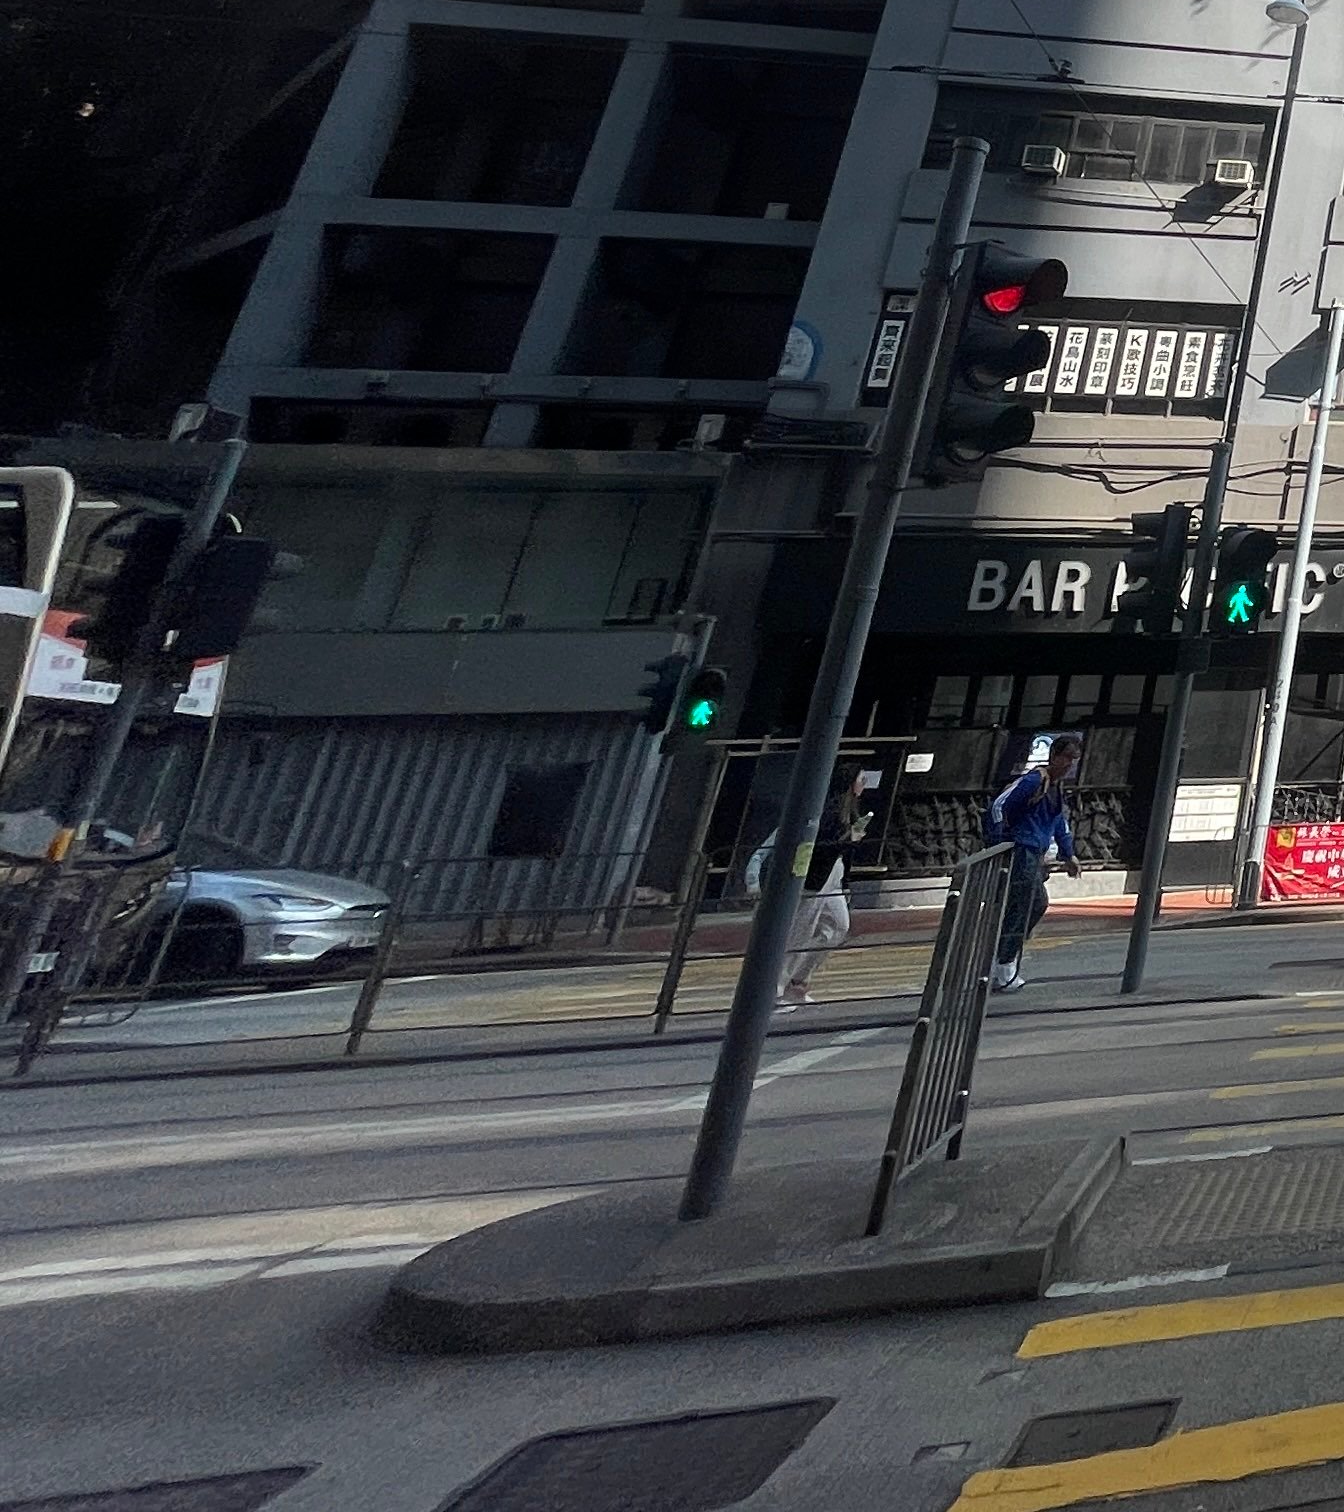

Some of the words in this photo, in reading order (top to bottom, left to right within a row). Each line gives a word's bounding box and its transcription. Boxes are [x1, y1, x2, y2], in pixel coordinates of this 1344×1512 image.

[1059, 332, 1084, 388] 花鳥山水
[1089, 332, 1115, 389] 篆刻印章
[1120, 334, 1144, 391] K歌技巧
[1149, 335, 1174, 392] 粵曲小調
[1179, 336, 1203, 393] 素食烹飪
[967, 559, 1093, 613] BAR
